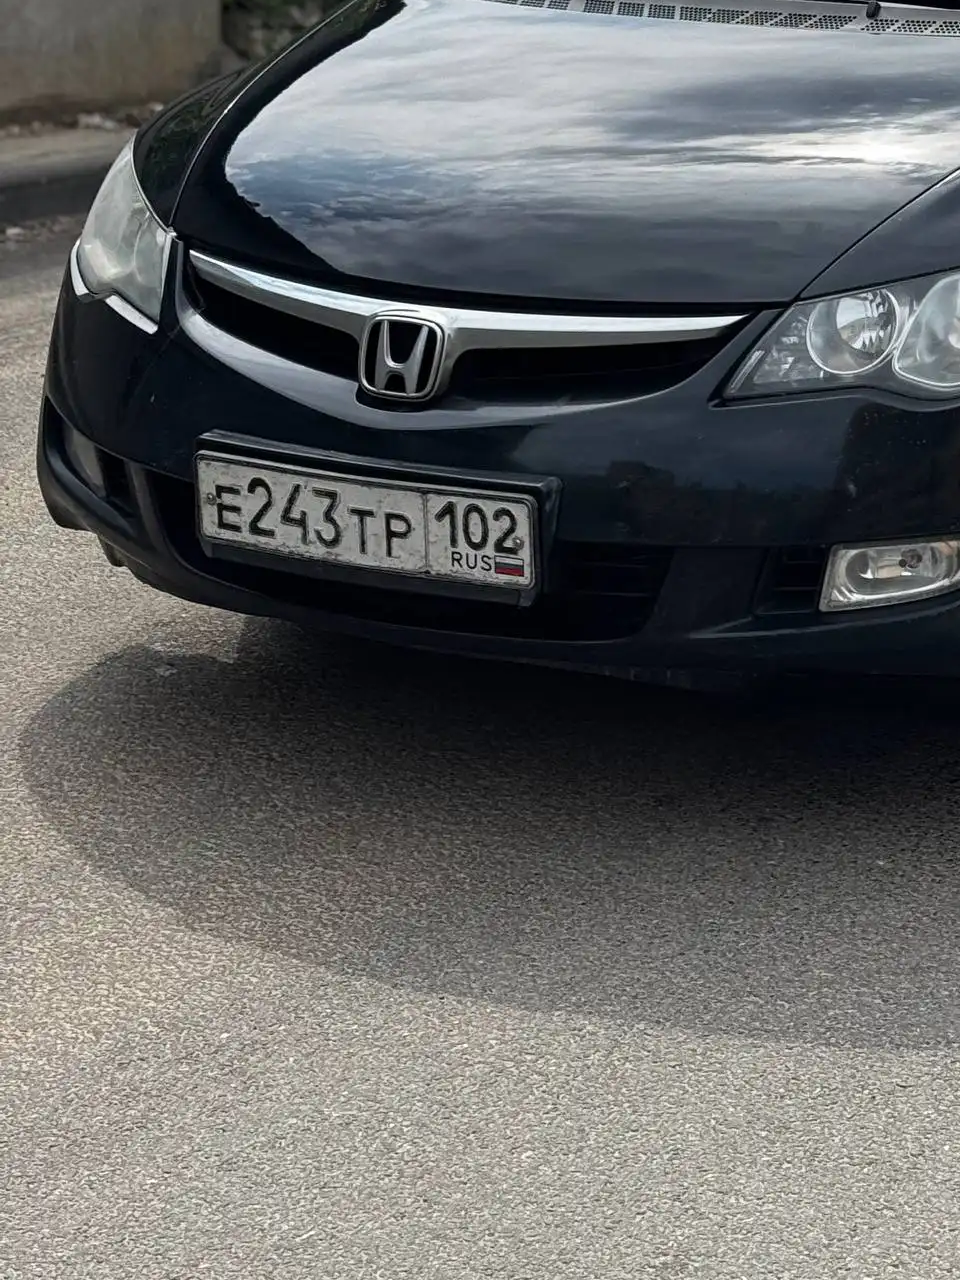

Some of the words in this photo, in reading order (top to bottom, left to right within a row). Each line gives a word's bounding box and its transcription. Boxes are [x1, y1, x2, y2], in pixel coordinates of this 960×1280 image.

[214, 477, 413, 558] E243TP
[434, 501, 519, 555] 102
[451, 551, 492, 572] RUS
